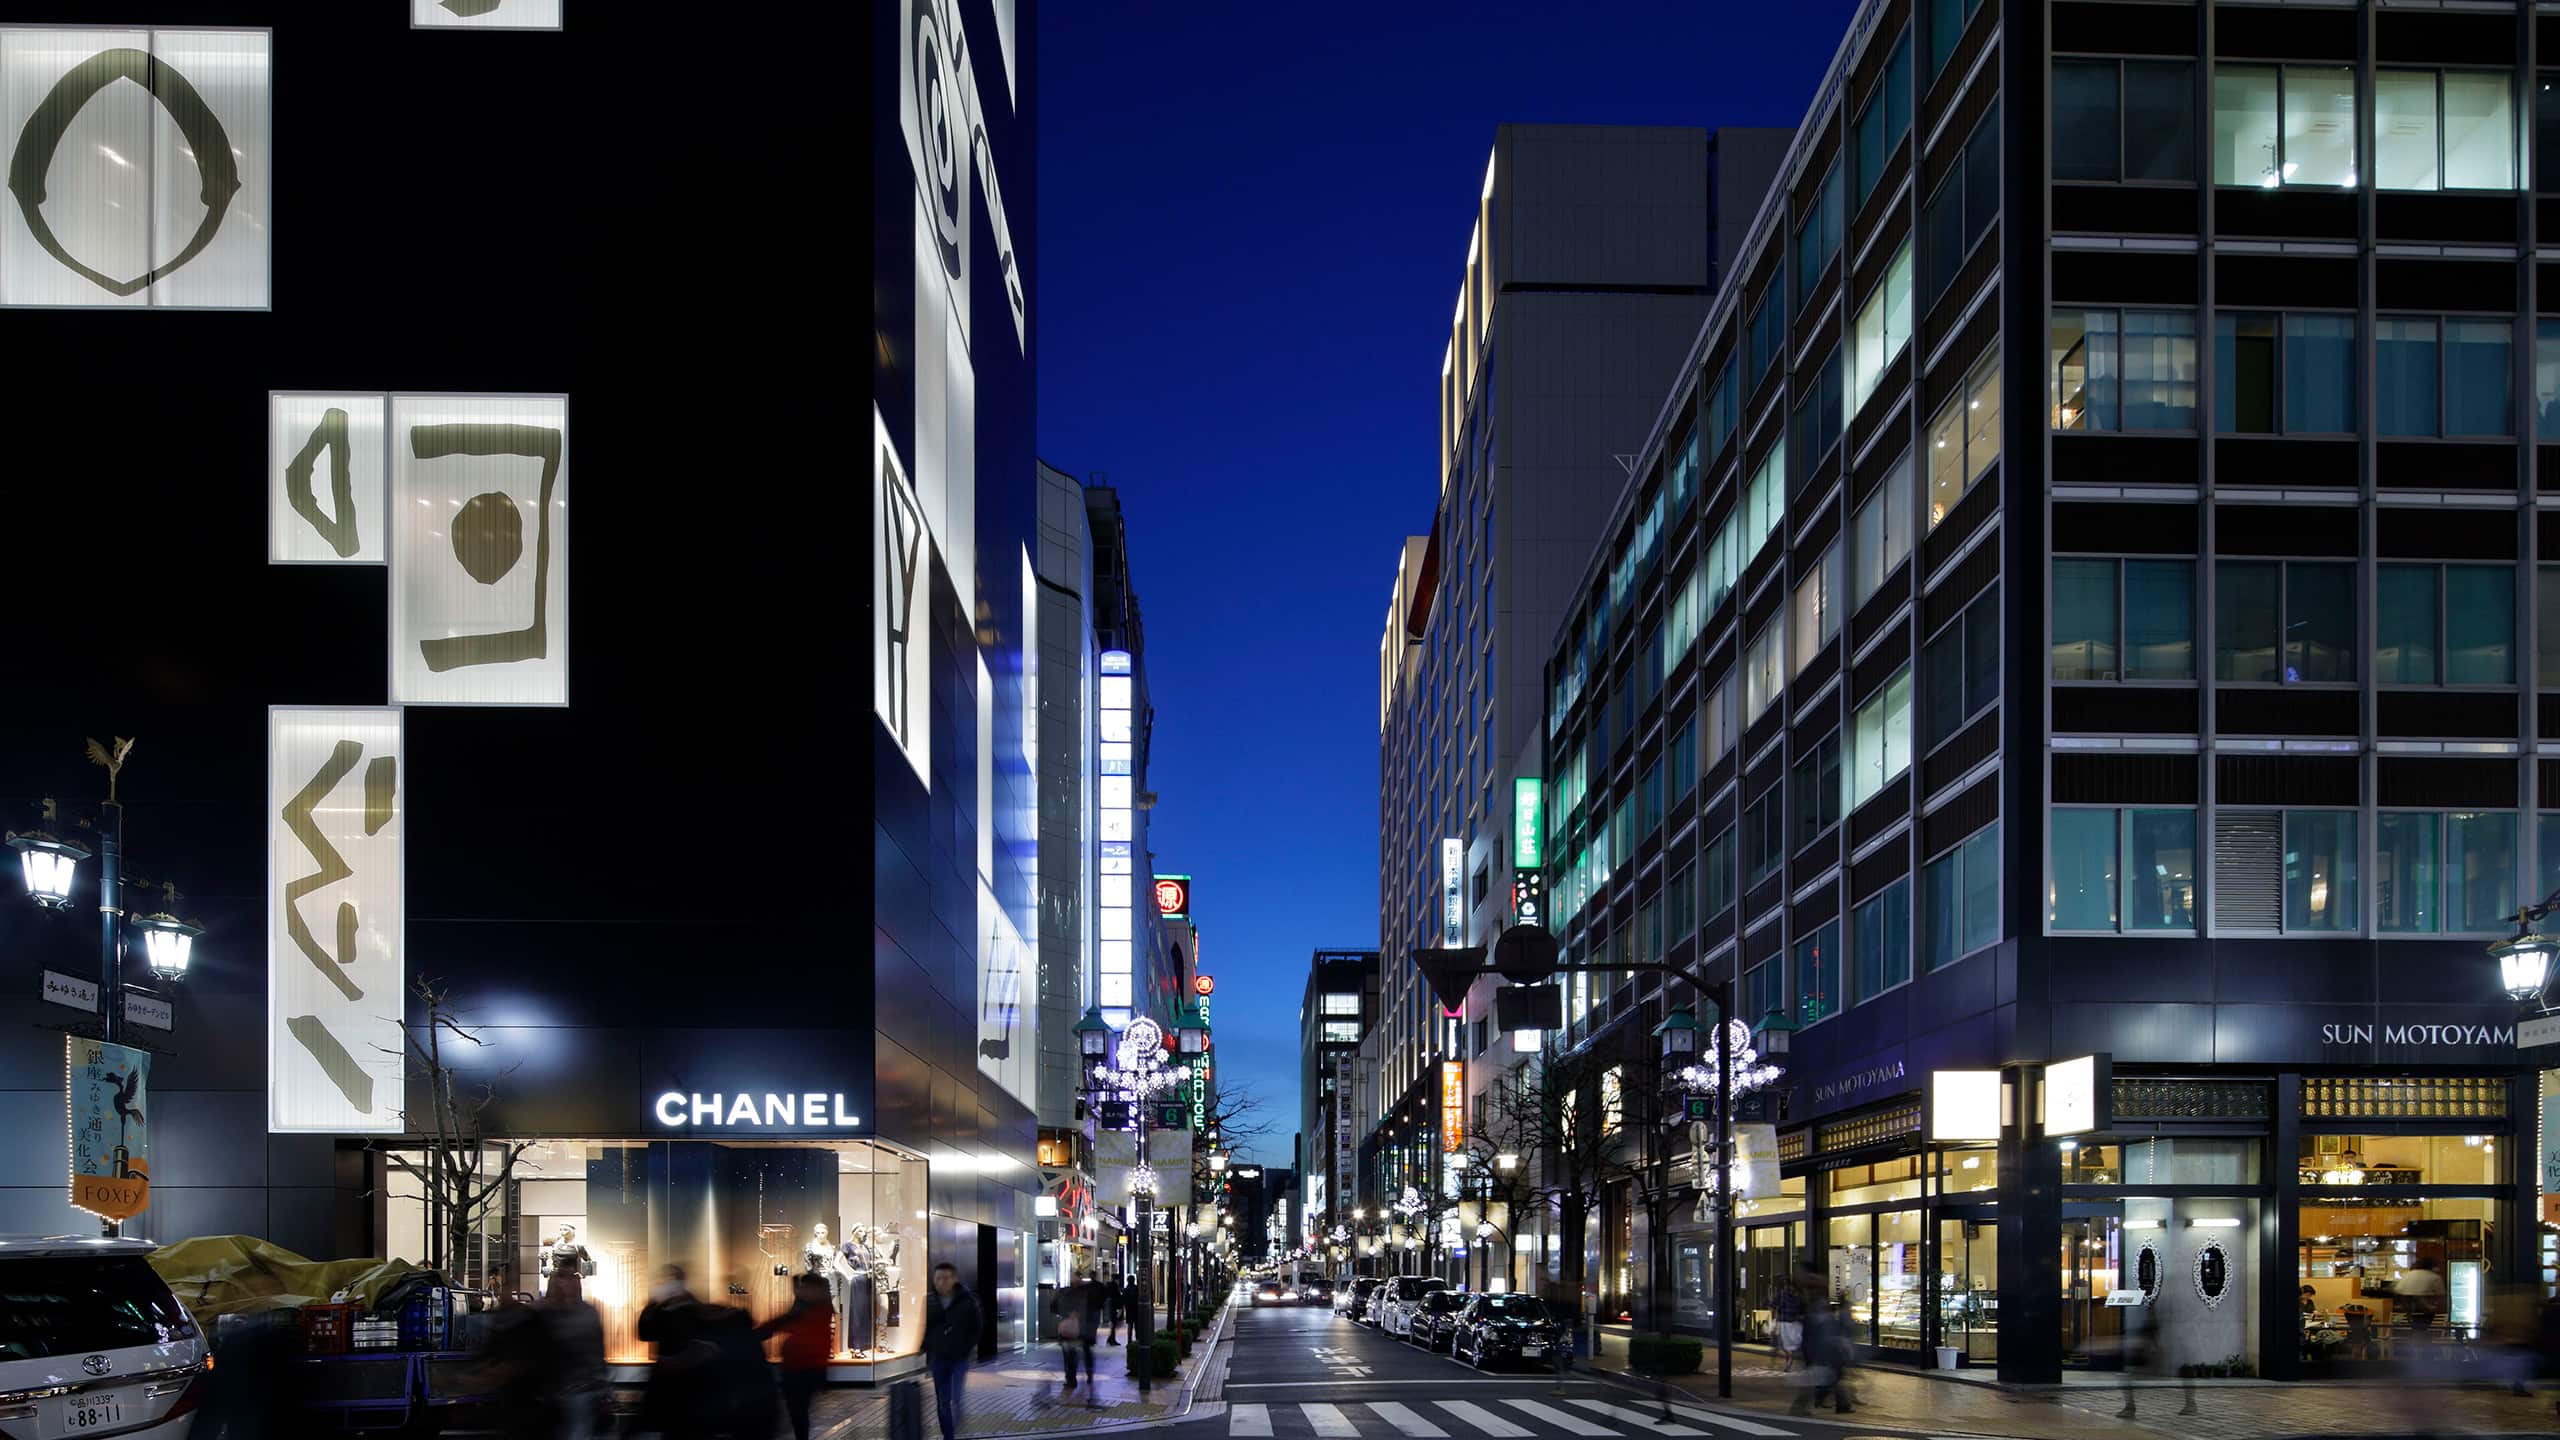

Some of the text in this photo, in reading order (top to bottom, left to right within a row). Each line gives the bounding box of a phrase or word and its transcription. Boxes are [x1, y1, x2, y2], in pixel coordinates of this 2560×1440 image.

[2321, 1023, 2374, 1045] SUN
[2384, 1024, 2515, 1045] MOTOYAM
[1815, 1061, 1905, 1103] SUN MOTOYAMA
[655, 1091, 861, 1127] CHANEL
[1165, 1104, 1178, 1123] 6
[84, 1184, 142, 1205] FOXEY
